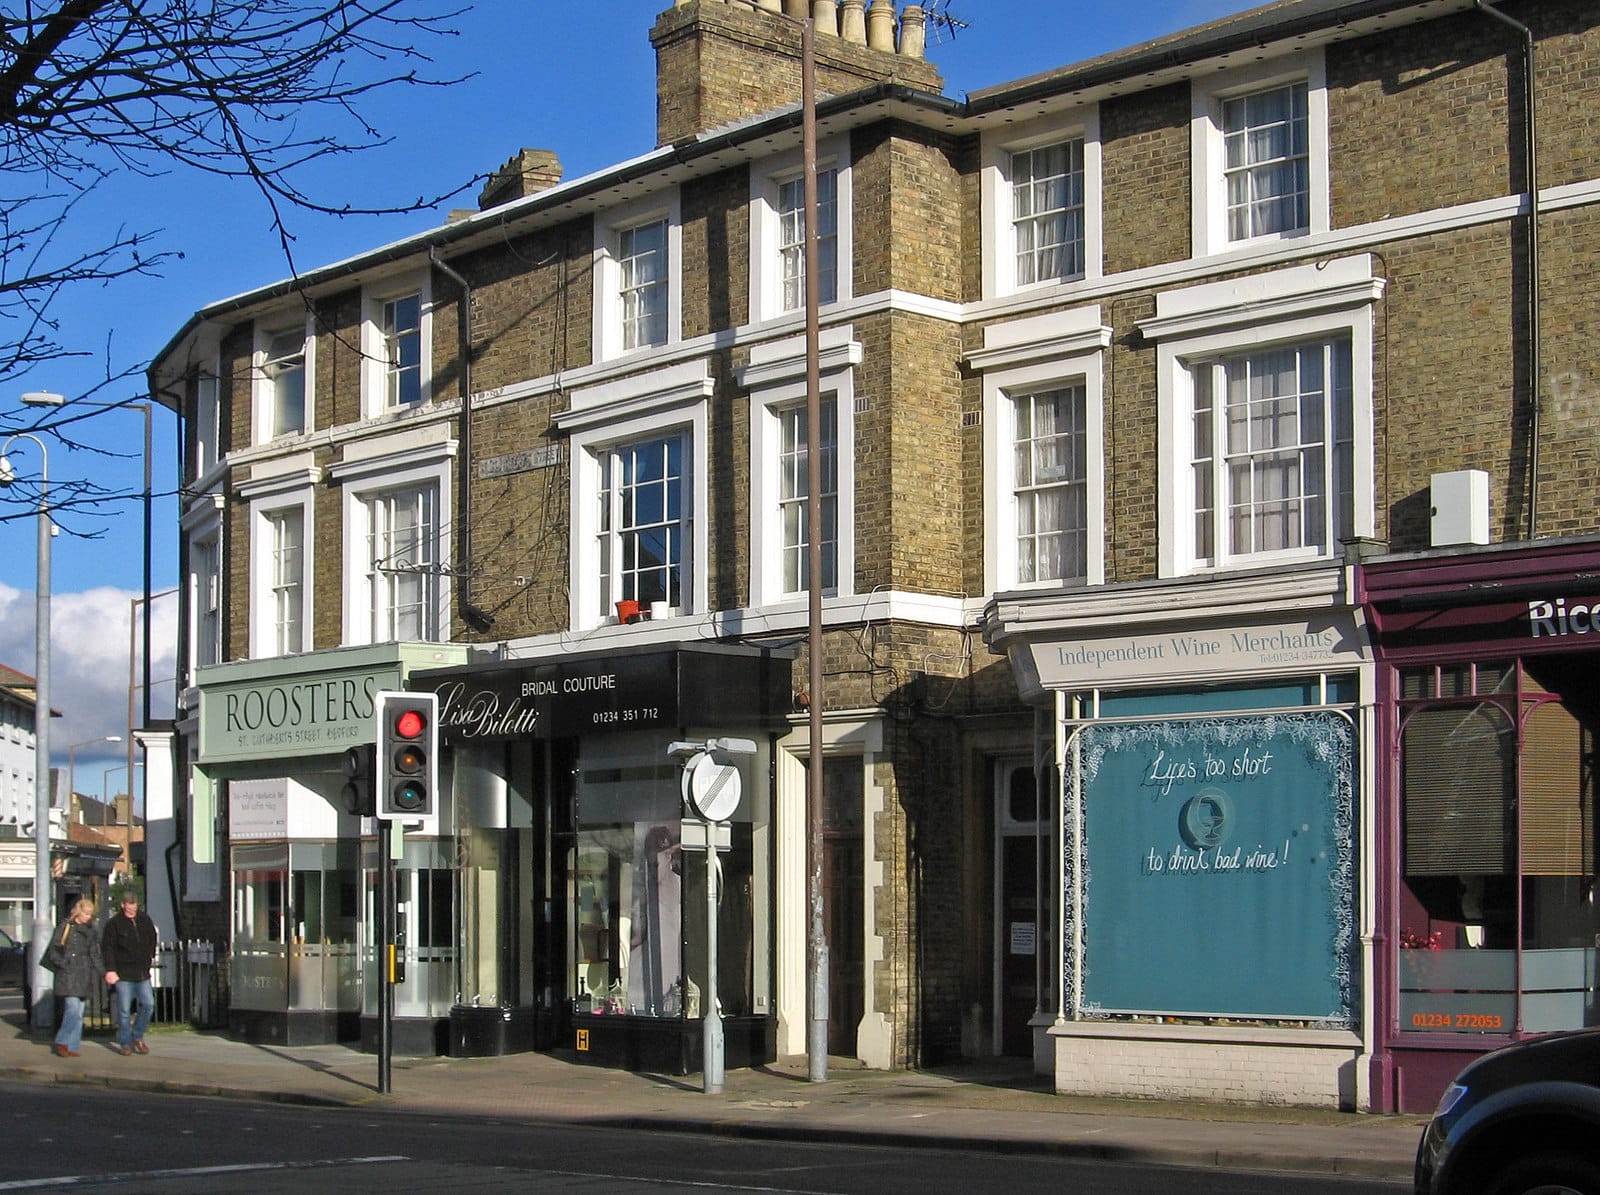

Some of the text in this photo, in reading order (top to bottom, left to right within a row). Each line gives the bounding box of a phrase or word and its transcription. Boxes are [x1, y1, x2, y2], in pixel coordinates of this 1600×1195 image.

[1058, 630, 1333, 668] Independent Wine Merchants
[521, 674, 616, 697] BRIDAL COUTURE
[226, 677, 375, 732] ROOSTERS
[434, 682, 474, 727] Lisa
[593, 707, 658, 723] 01234 351 712
[1150, 748, 1274, 796] Life's too short
[1147, 847, 1163, 871] to
[1168, 844, 1209, 870] drink
[1214, 846, 1241, 869] bad
[1412, 1013, 1503, 1028] 01234 272053
